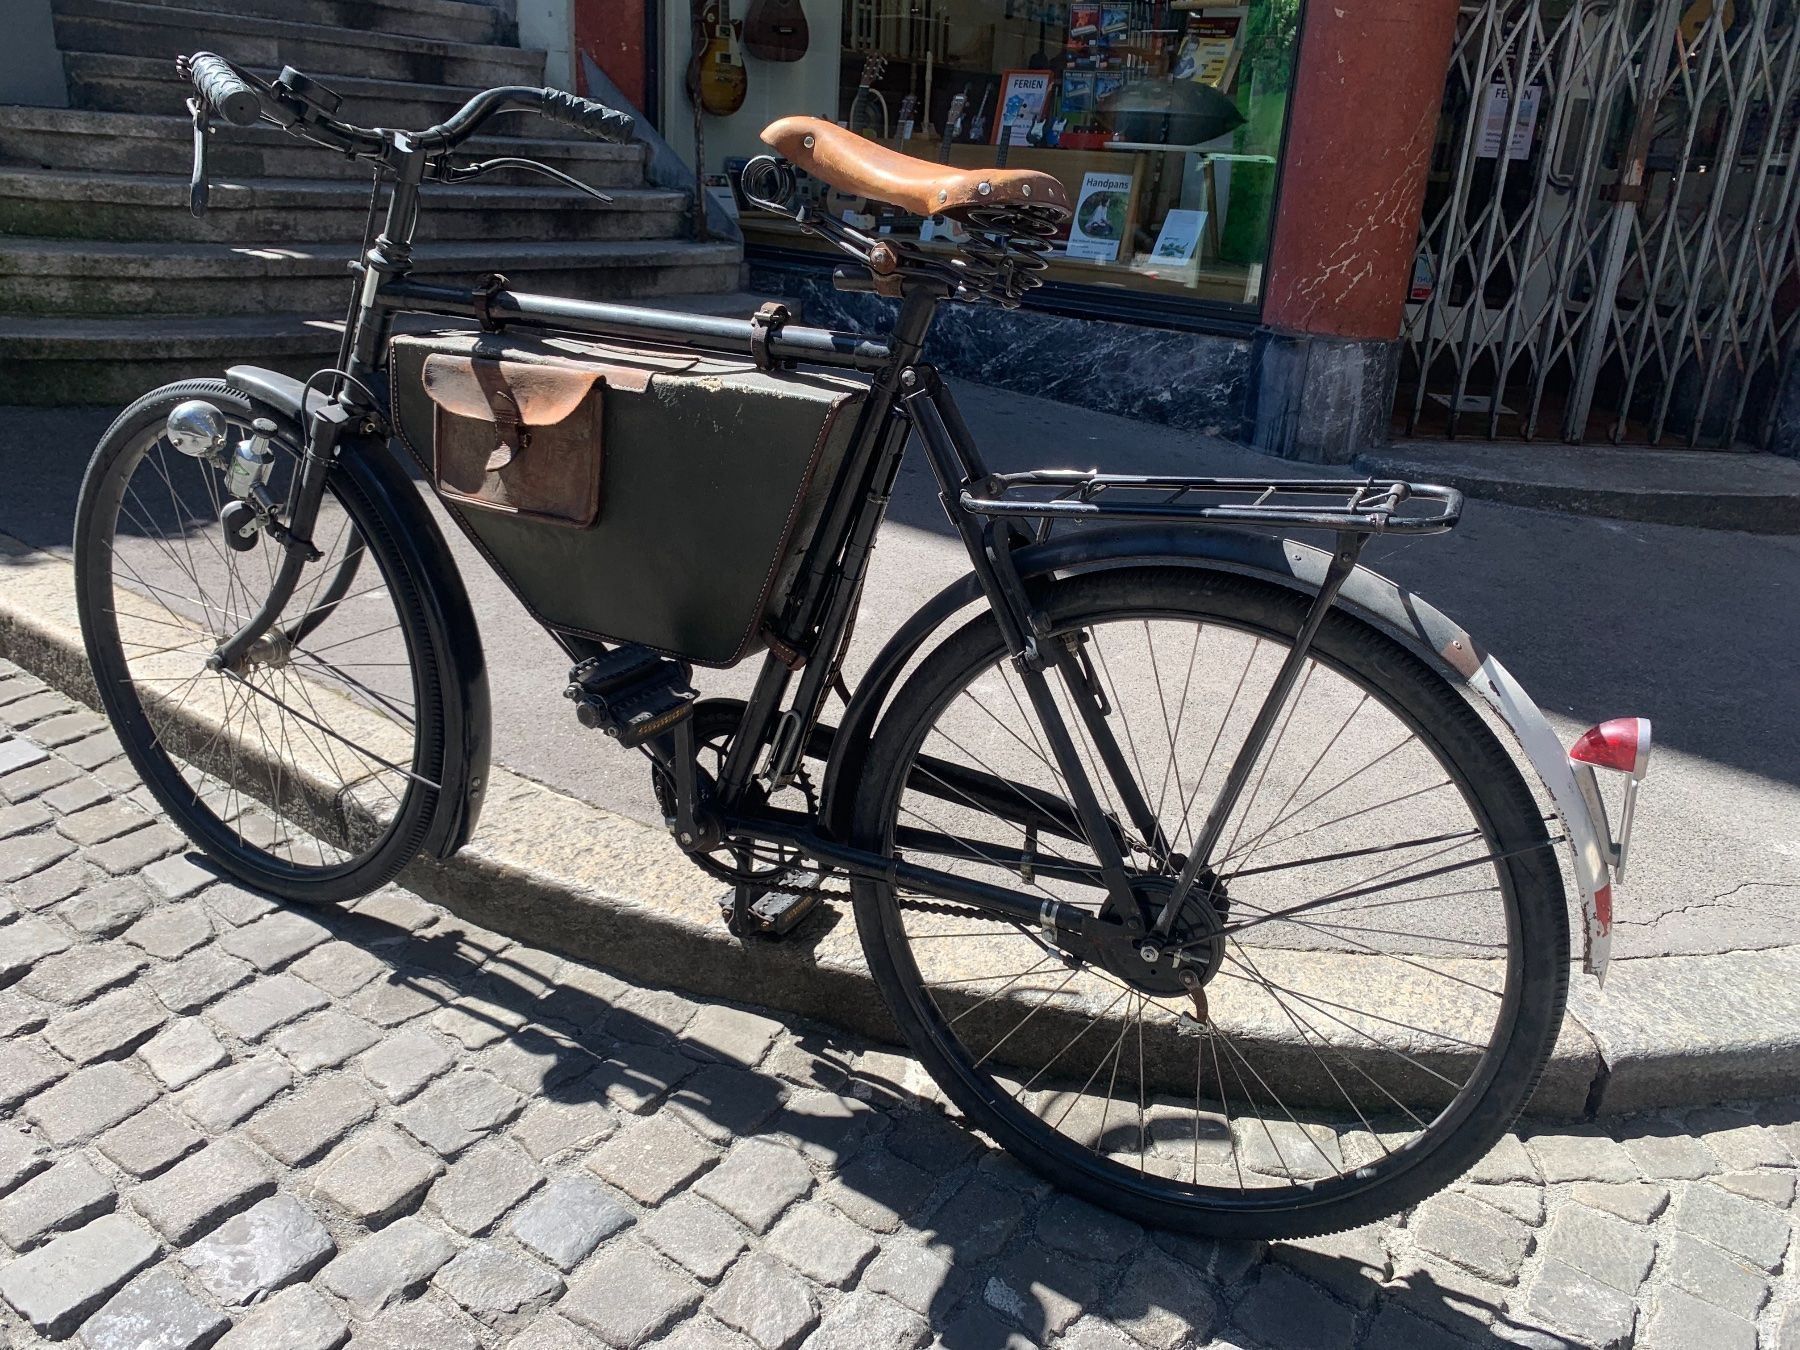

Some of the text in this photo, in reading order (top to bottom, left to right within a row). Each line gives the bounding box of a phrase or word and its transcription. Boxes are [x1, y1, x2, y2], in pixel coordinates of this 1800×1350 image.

[1013, 79, 1044, 89] FERIEN
[1495, 88, 1532, 100] FEN
[1086, 178, 1129, 190] Handpans
